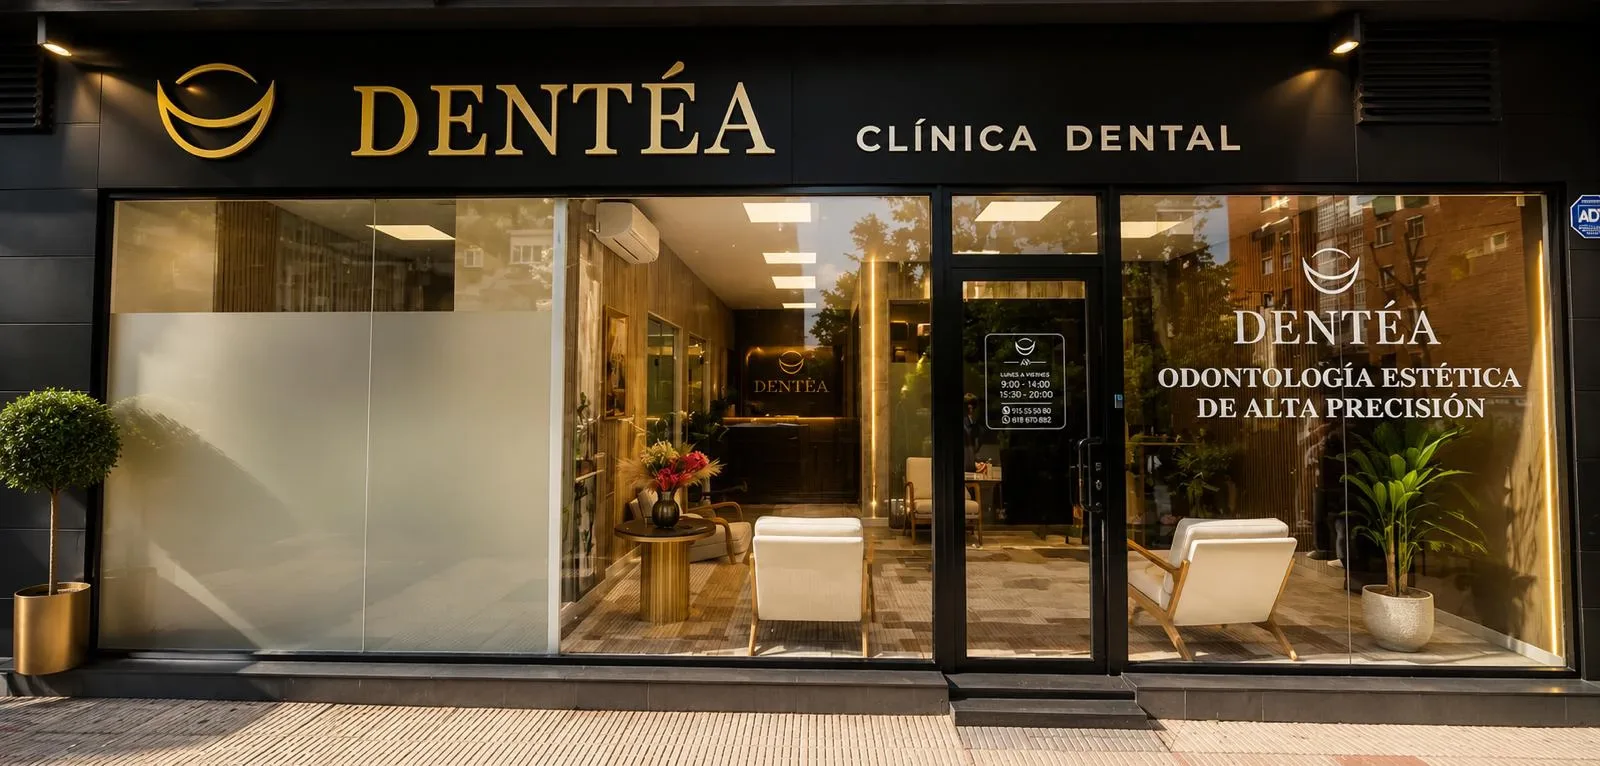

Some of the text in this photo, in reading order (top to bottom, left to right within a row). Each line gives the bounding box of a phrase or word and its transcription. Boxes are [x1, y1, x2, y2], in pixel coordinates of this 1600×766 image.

[351, 61, 776, 156] DENTÉA
[856, 118, 1241, 152] CLÍNICA DENTAL
[1578, 207, 1600, 223] AD
[1233, 300, 1441, 346] DENTÉA
[754, 377, 830, 393] DENTÉA
[1028, 380, 1050, 388] 14:00
[1157, 362, 1522, 388] ODONTOLOGÍA ESTÉTICA
[1196, 393, 1485, 419] DE ALTA PRECISIÓN
